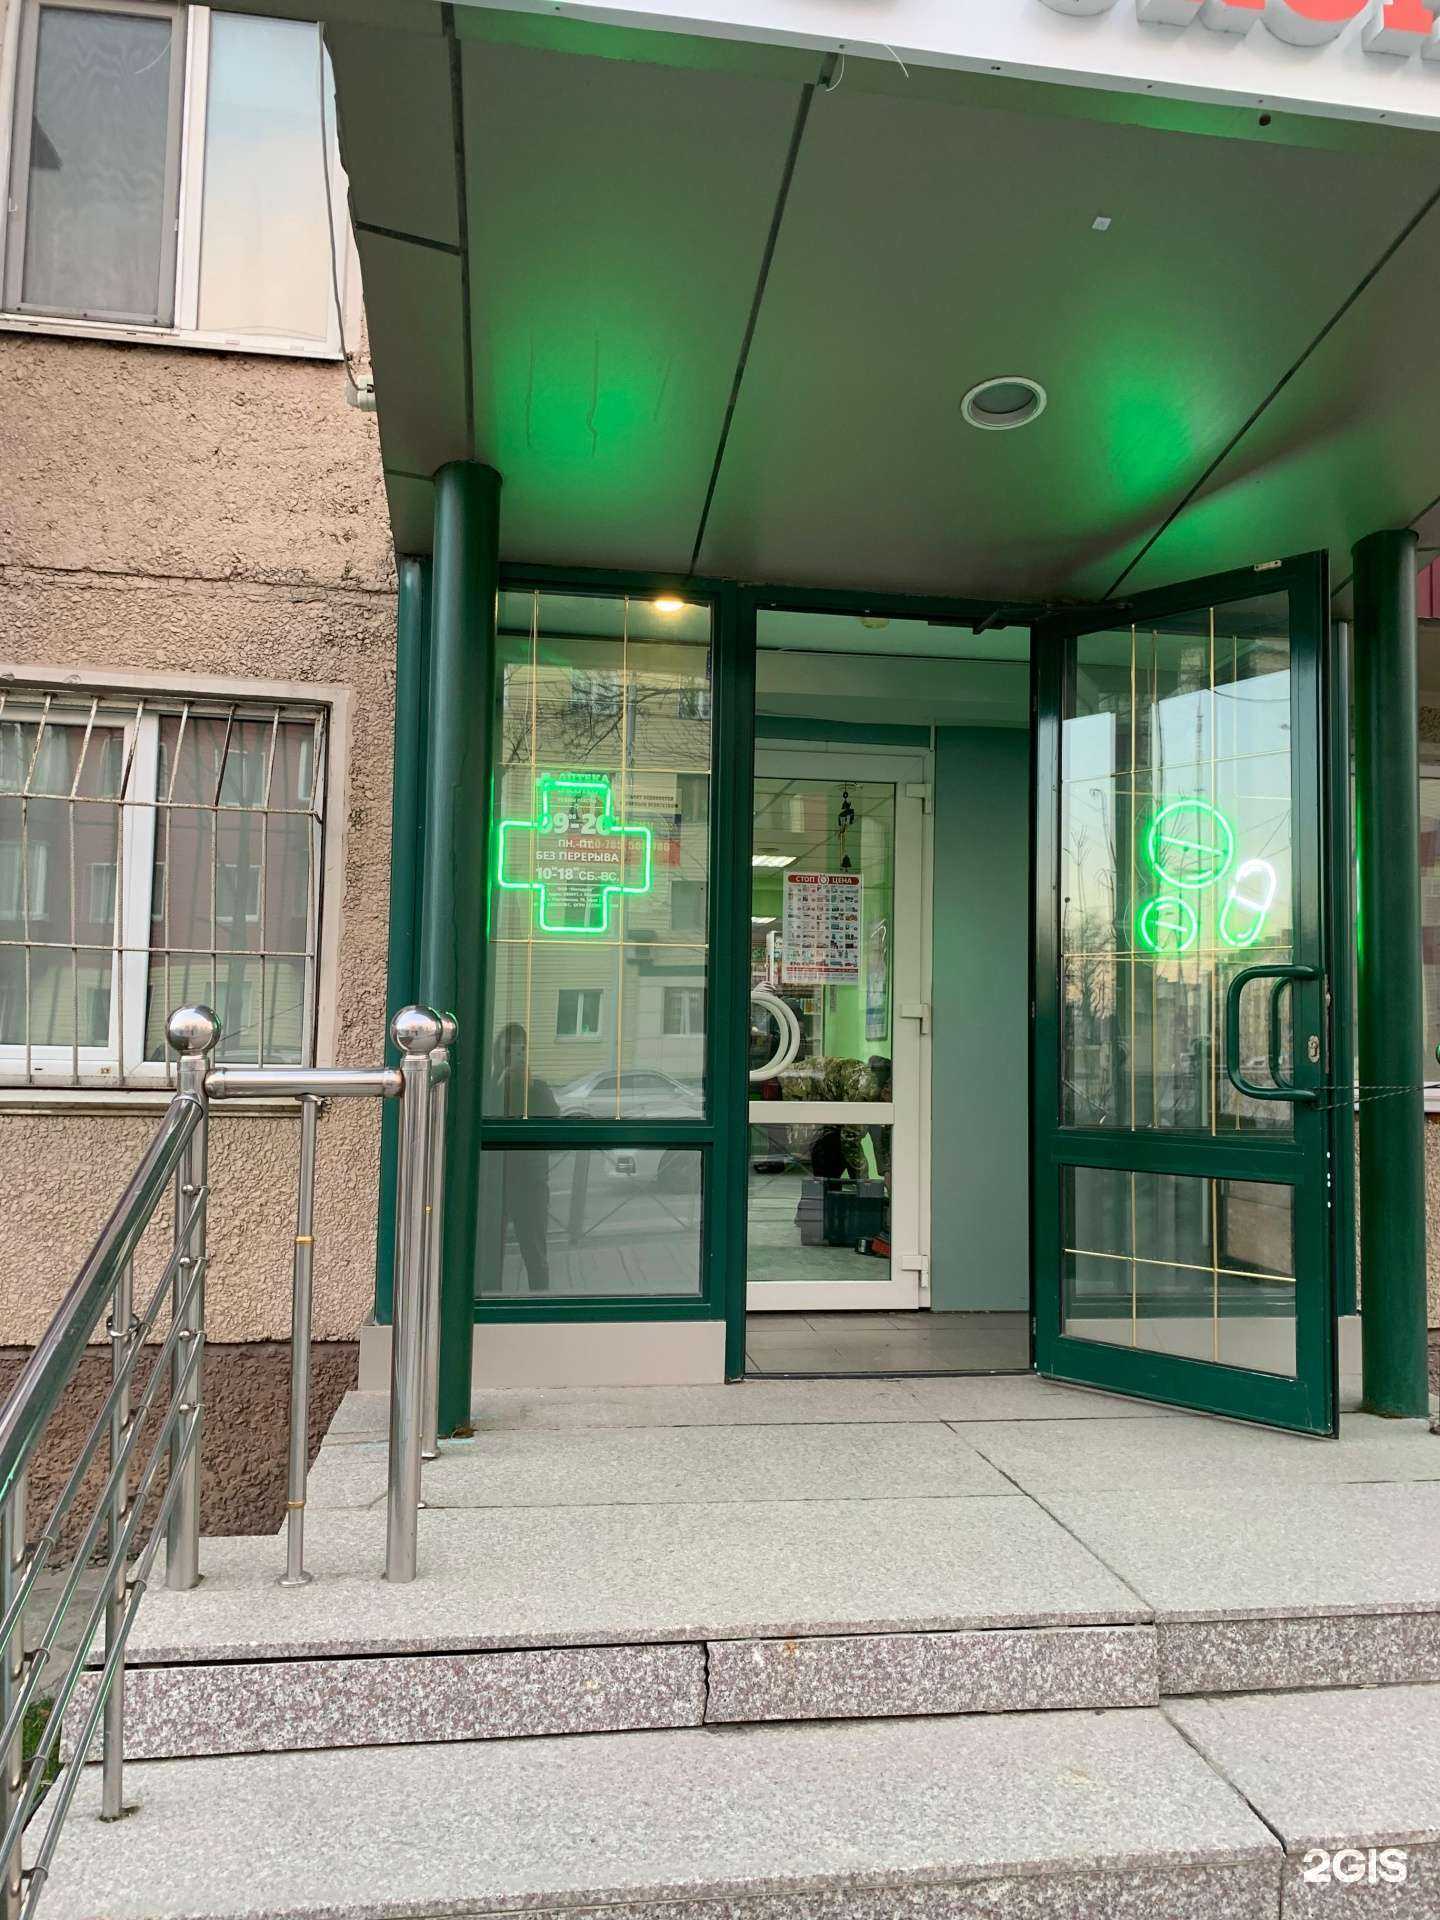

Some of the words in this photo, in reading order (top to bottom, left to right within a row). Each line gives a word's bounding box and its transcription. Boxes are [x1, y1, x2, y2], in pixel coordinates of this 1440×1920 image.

[535, 850, 556, 861] БЕЗ
[558, 851, 619, 863] ПЕРЕРЫВА
[795, 875, 815, 883] СТОП
[832, 876, 852, 884] ЦЕНА
